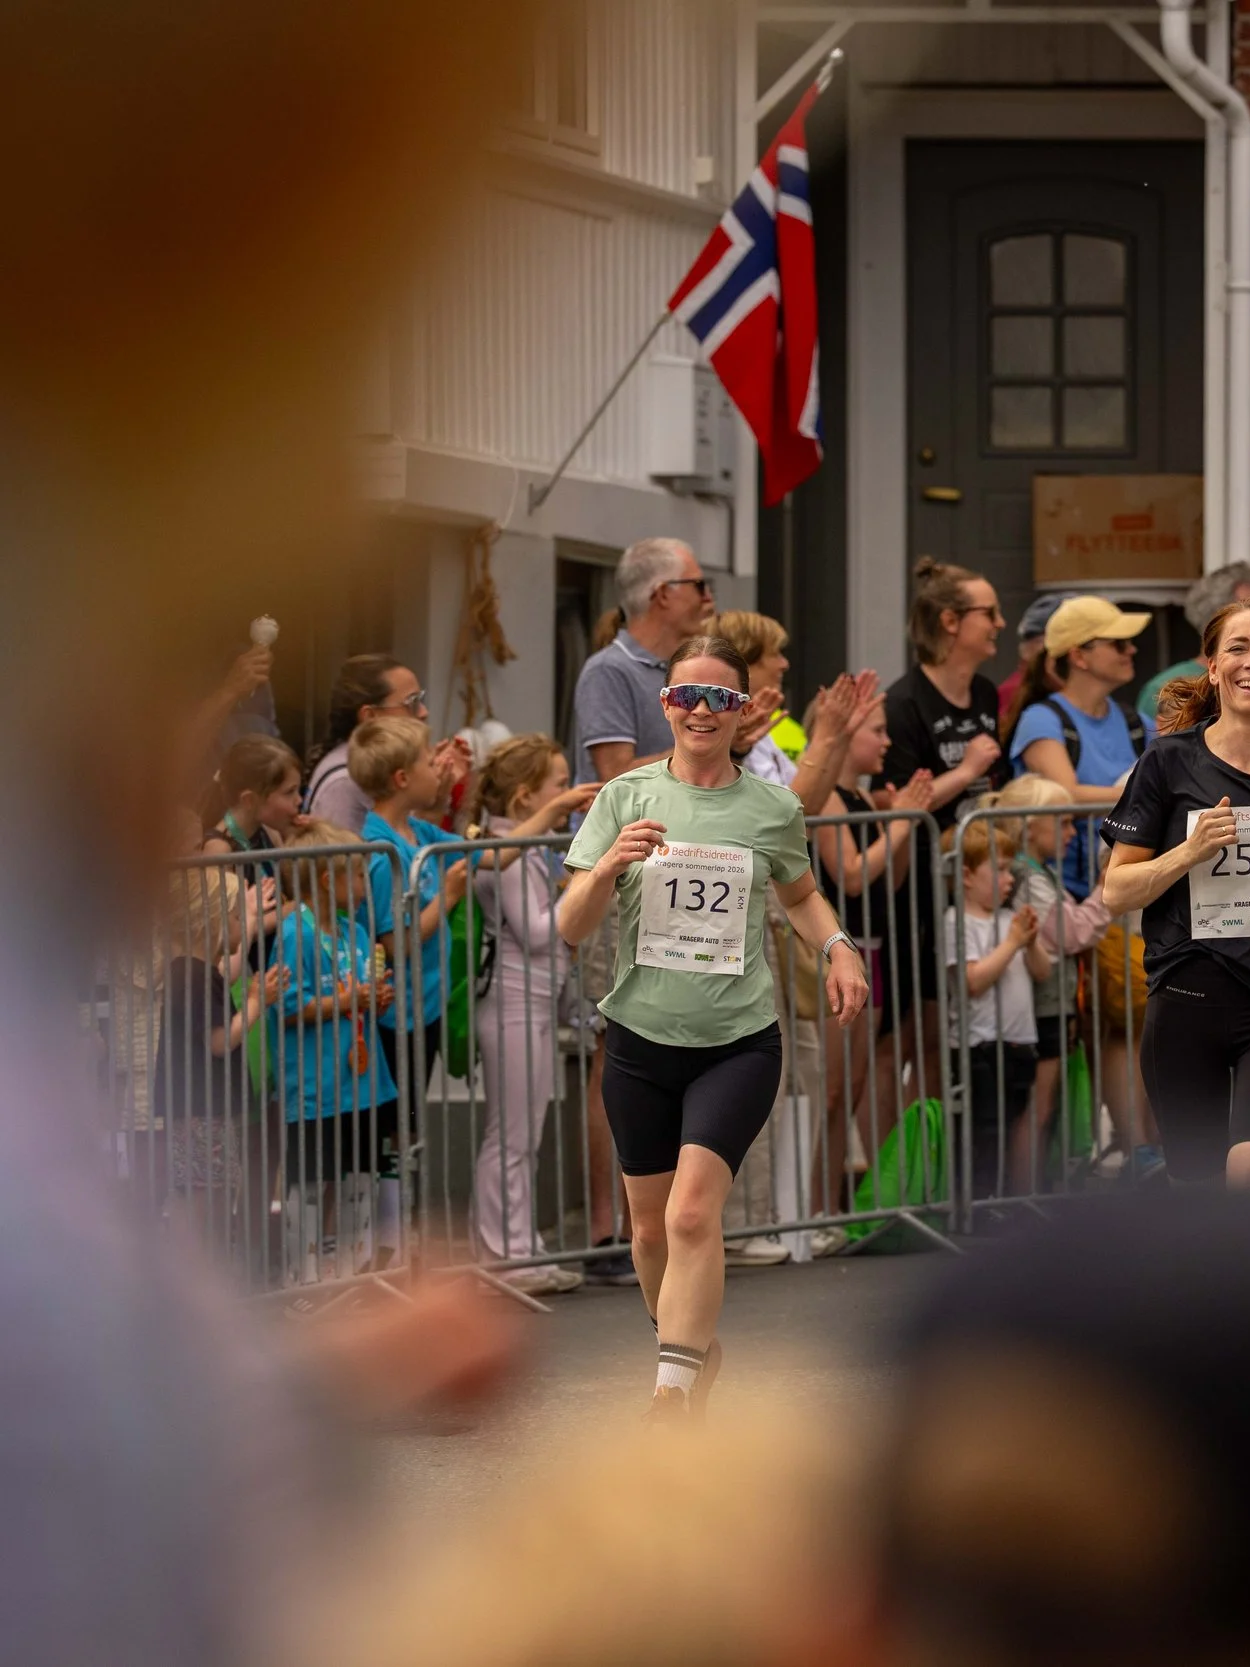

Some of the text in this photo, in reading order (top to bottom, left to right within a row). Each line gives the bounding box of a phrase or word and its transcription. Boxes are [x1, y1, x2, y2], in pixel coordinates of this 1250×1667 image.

[672, 847, 744, 861] Bedriftsidretten
[655, 860, 683, 869] Kragerø
[685, 864, 725, 873] sommerløp
[665, 878, 730, 913] 132
[737, 896, 745, 910] KM
[679, 935, 704, 943] KRAGERØ
[705, 937, 719, 945] AUTO
[665, 950, 686, 959] SWML
[1166, 986, 1205, 997] ENDURANCE
